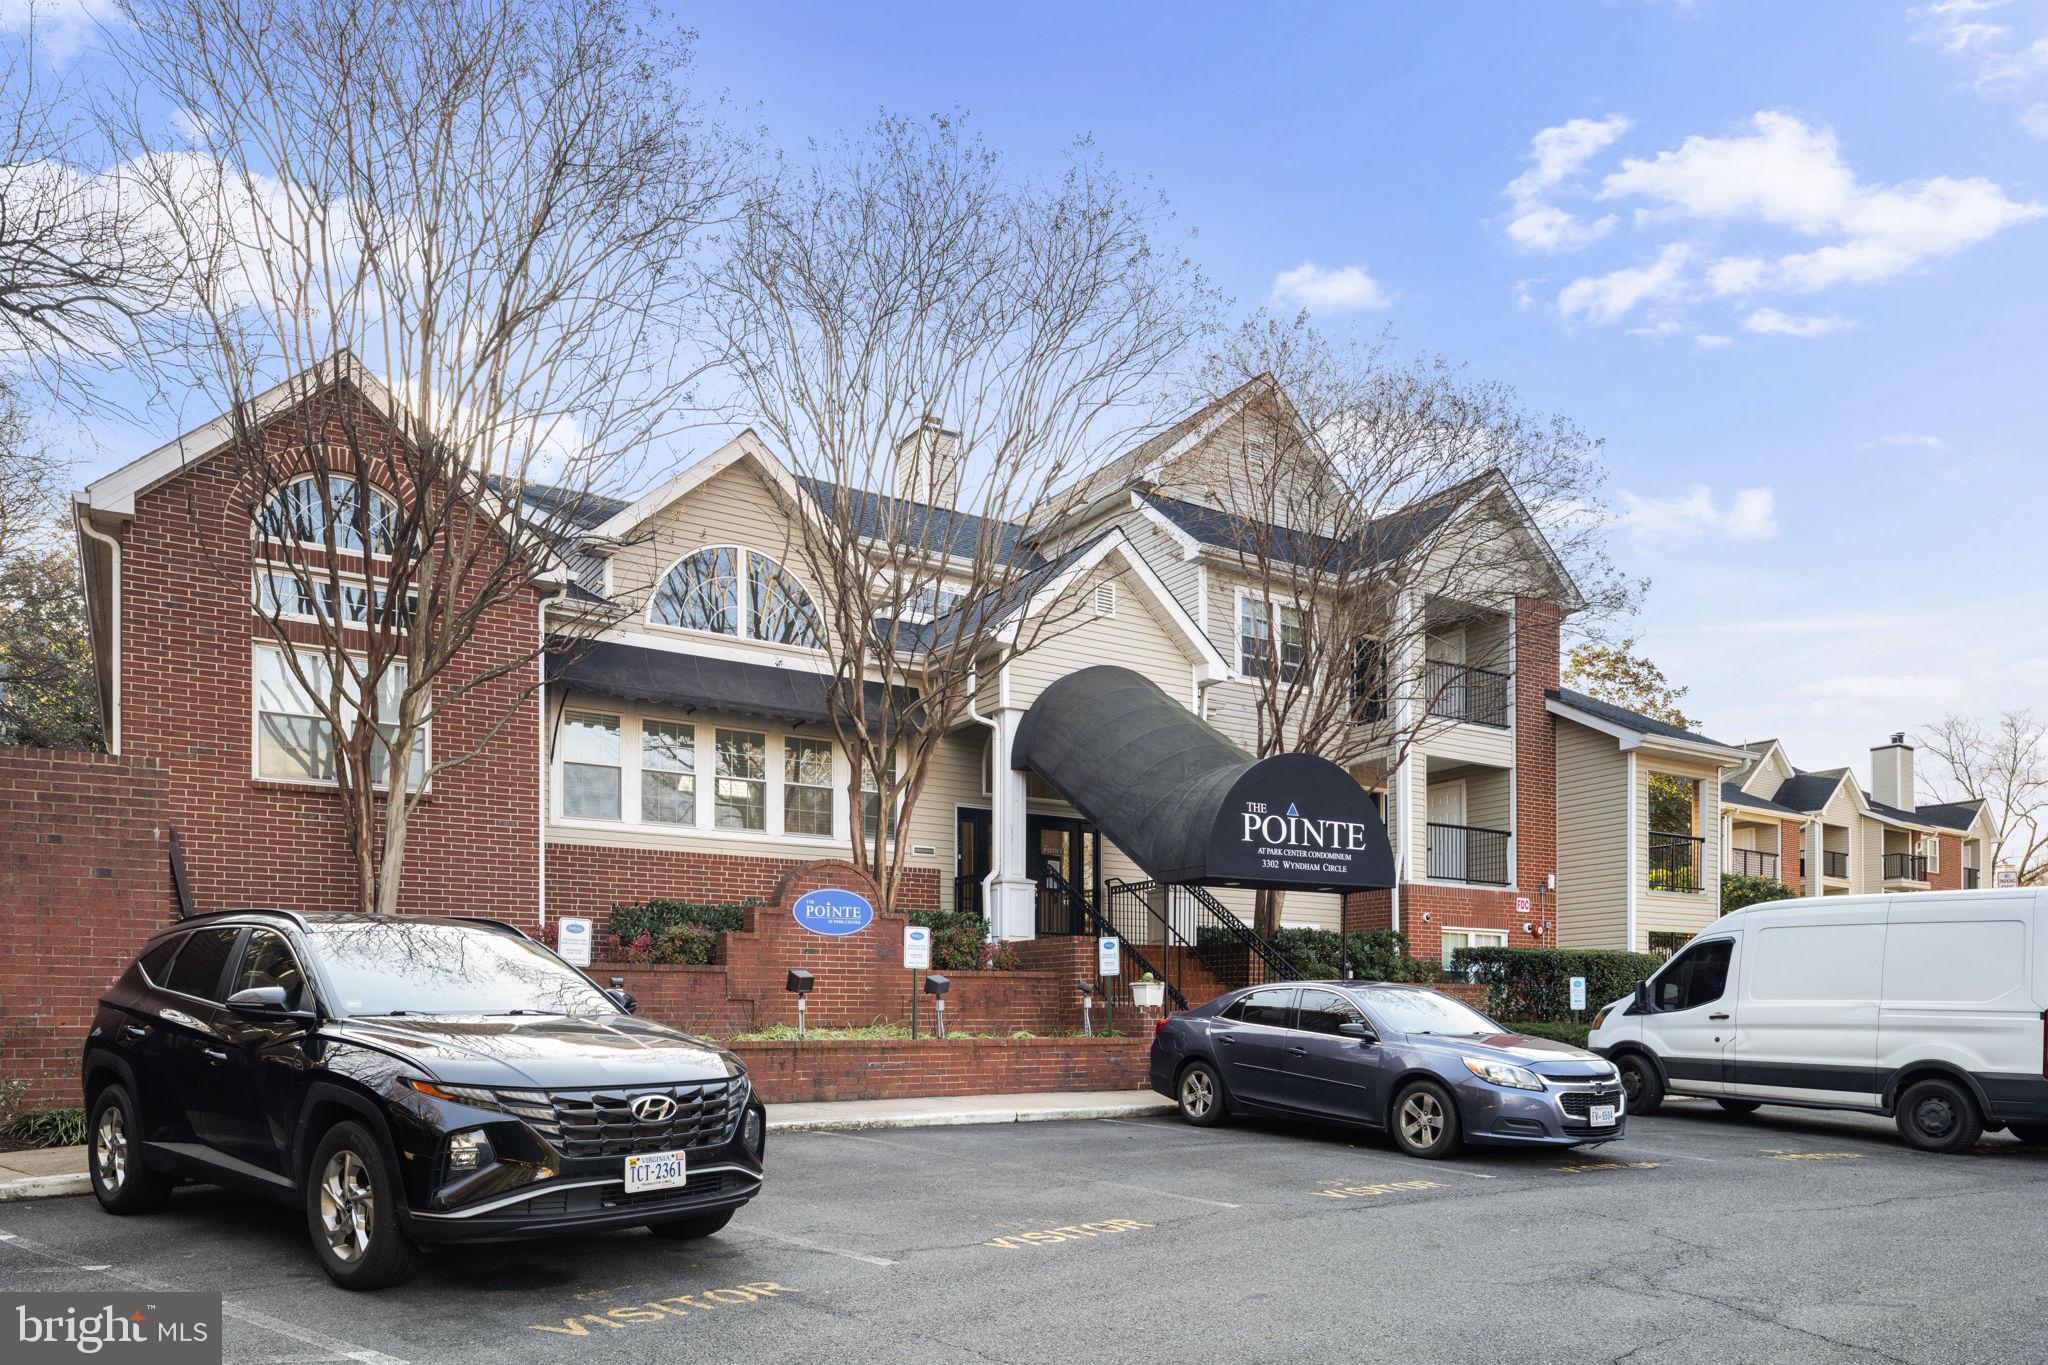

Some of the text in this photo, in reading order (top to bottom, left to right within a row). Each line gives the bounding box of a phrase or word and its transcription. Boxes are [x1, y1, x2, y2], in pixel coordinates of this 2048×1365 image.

[1246, 802, 1267, 813] THE
[1241, 811, 1366, 851] POINTE
[1266, 848, 1283, 856] PARK
[1283, 849, 1308, 858] CENTER
[1308, 851, 1352, 861] CONDOMINIUM
[1262, 859, 1279, 869] 3302
[806, 904, 861, 918] POINTE
[1517, 900, 1529, 910] FDC
[642, 1155, 670, 1164] VIRGINIA
[630, 1161, 682, 1183] TCT-2361
[1308, 1180, 1451, 1199] VISITOR
[974, 1219, 1155, 1249] VISITOR
[528, 1281, 801, 1336] VISITOR
